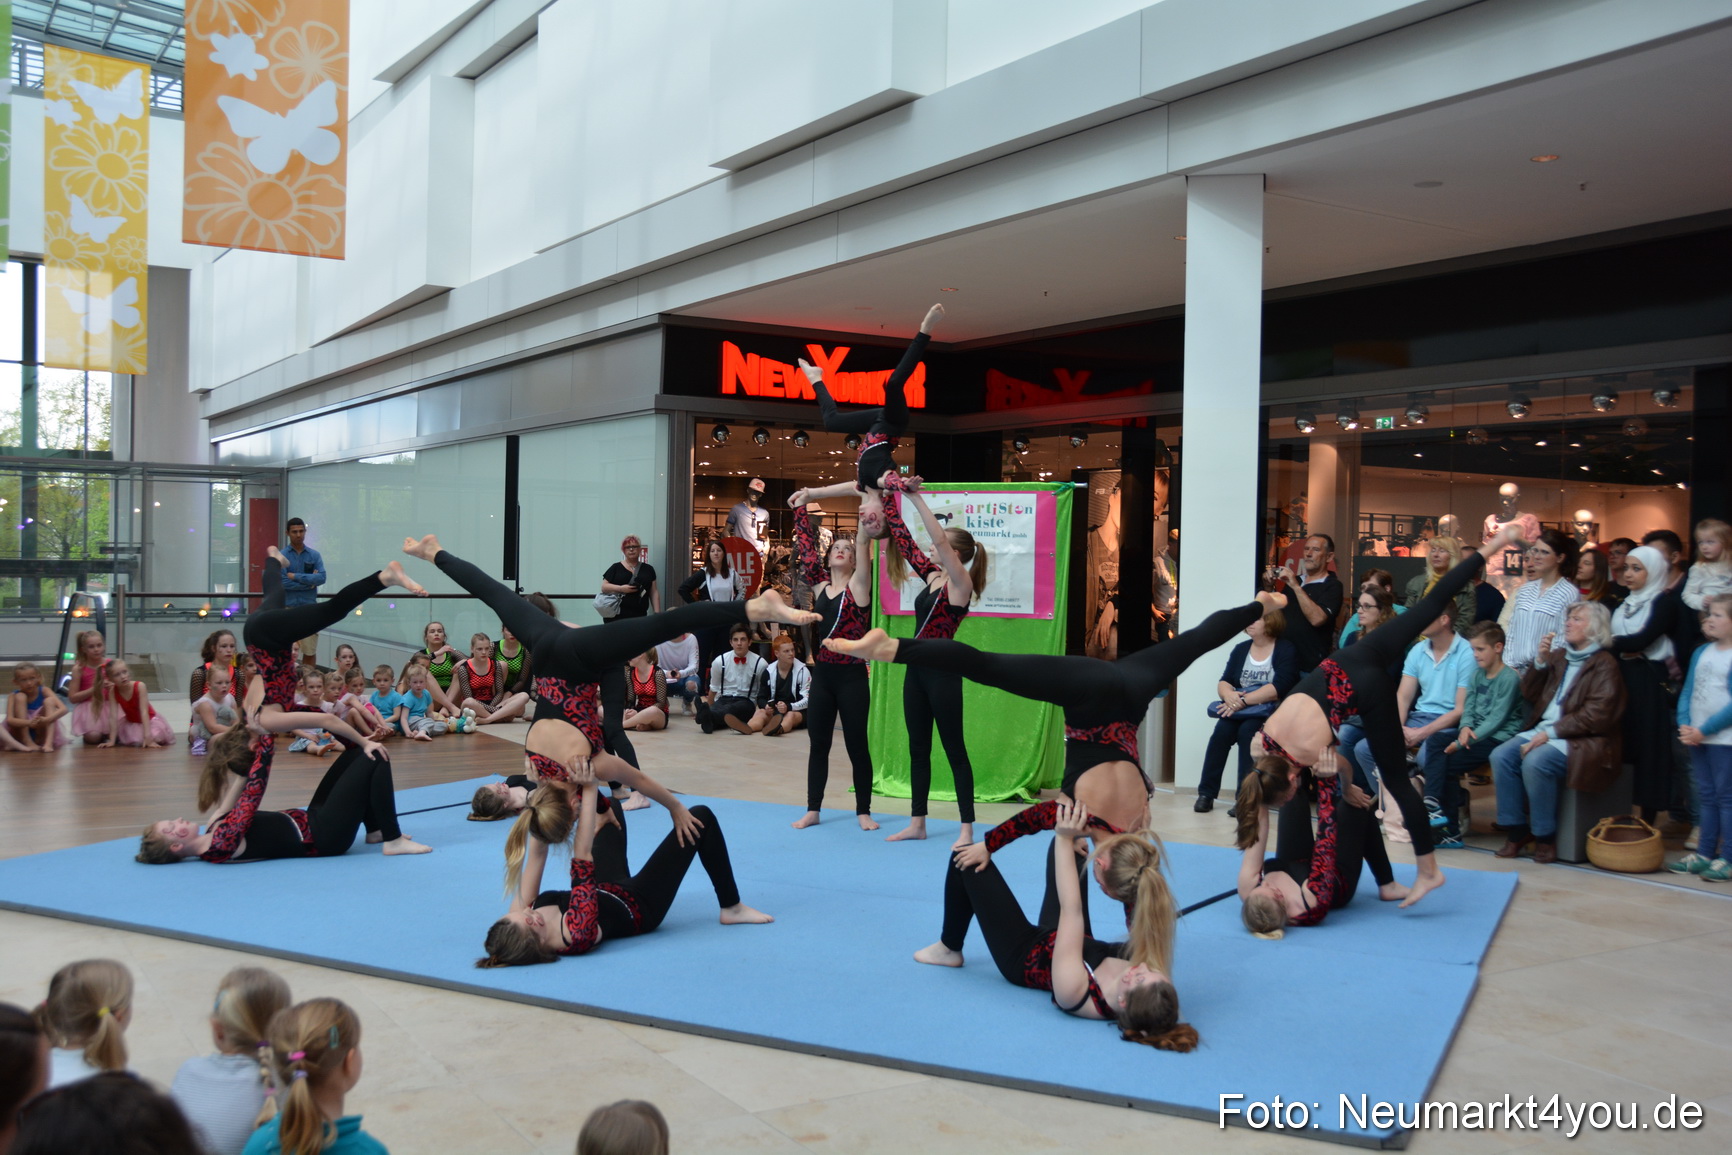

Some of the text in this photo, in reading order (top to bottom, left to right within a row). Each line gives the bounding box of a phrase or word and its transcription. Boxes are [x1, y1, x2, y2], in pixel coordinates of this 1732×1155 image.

[966, 516, 1004, 528] kiste
[727, 552, 755, 575] ALE
[1505, 553, 1521, 568] 14
